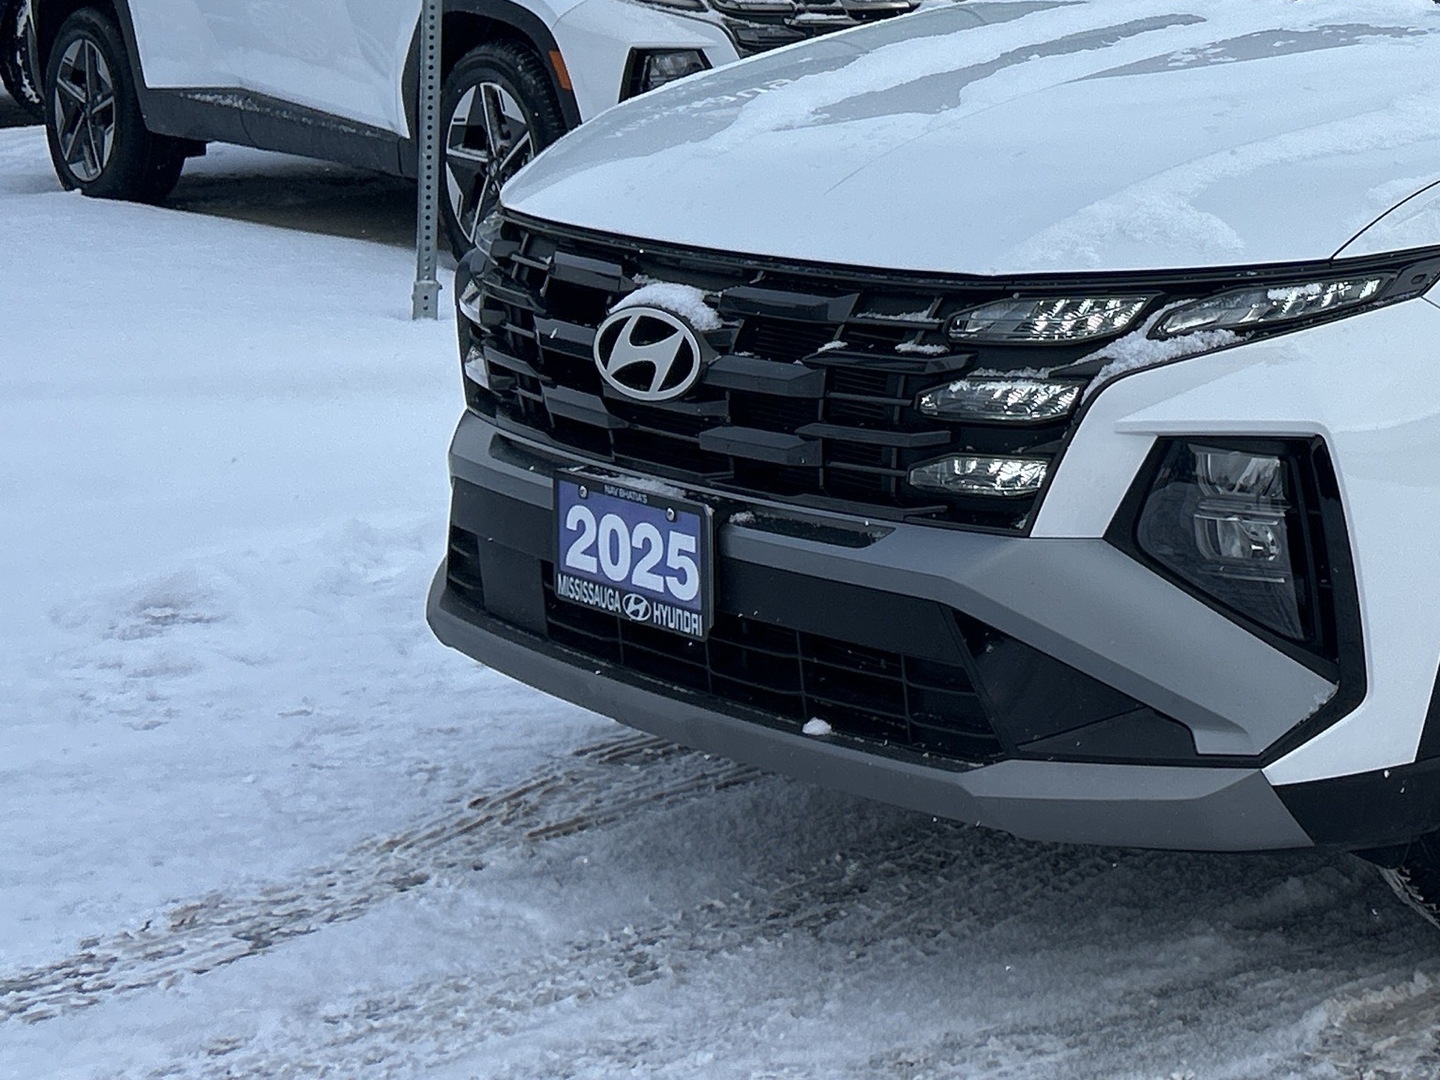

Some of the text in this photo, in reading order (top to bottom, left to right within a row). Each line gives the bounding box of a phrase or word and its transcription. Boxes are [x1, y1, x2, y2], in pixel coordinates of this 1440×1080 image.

[565, 505, 700, 601] 2025
[557, 573, 703, 637] MISSISSAUGA HYUNDAI
